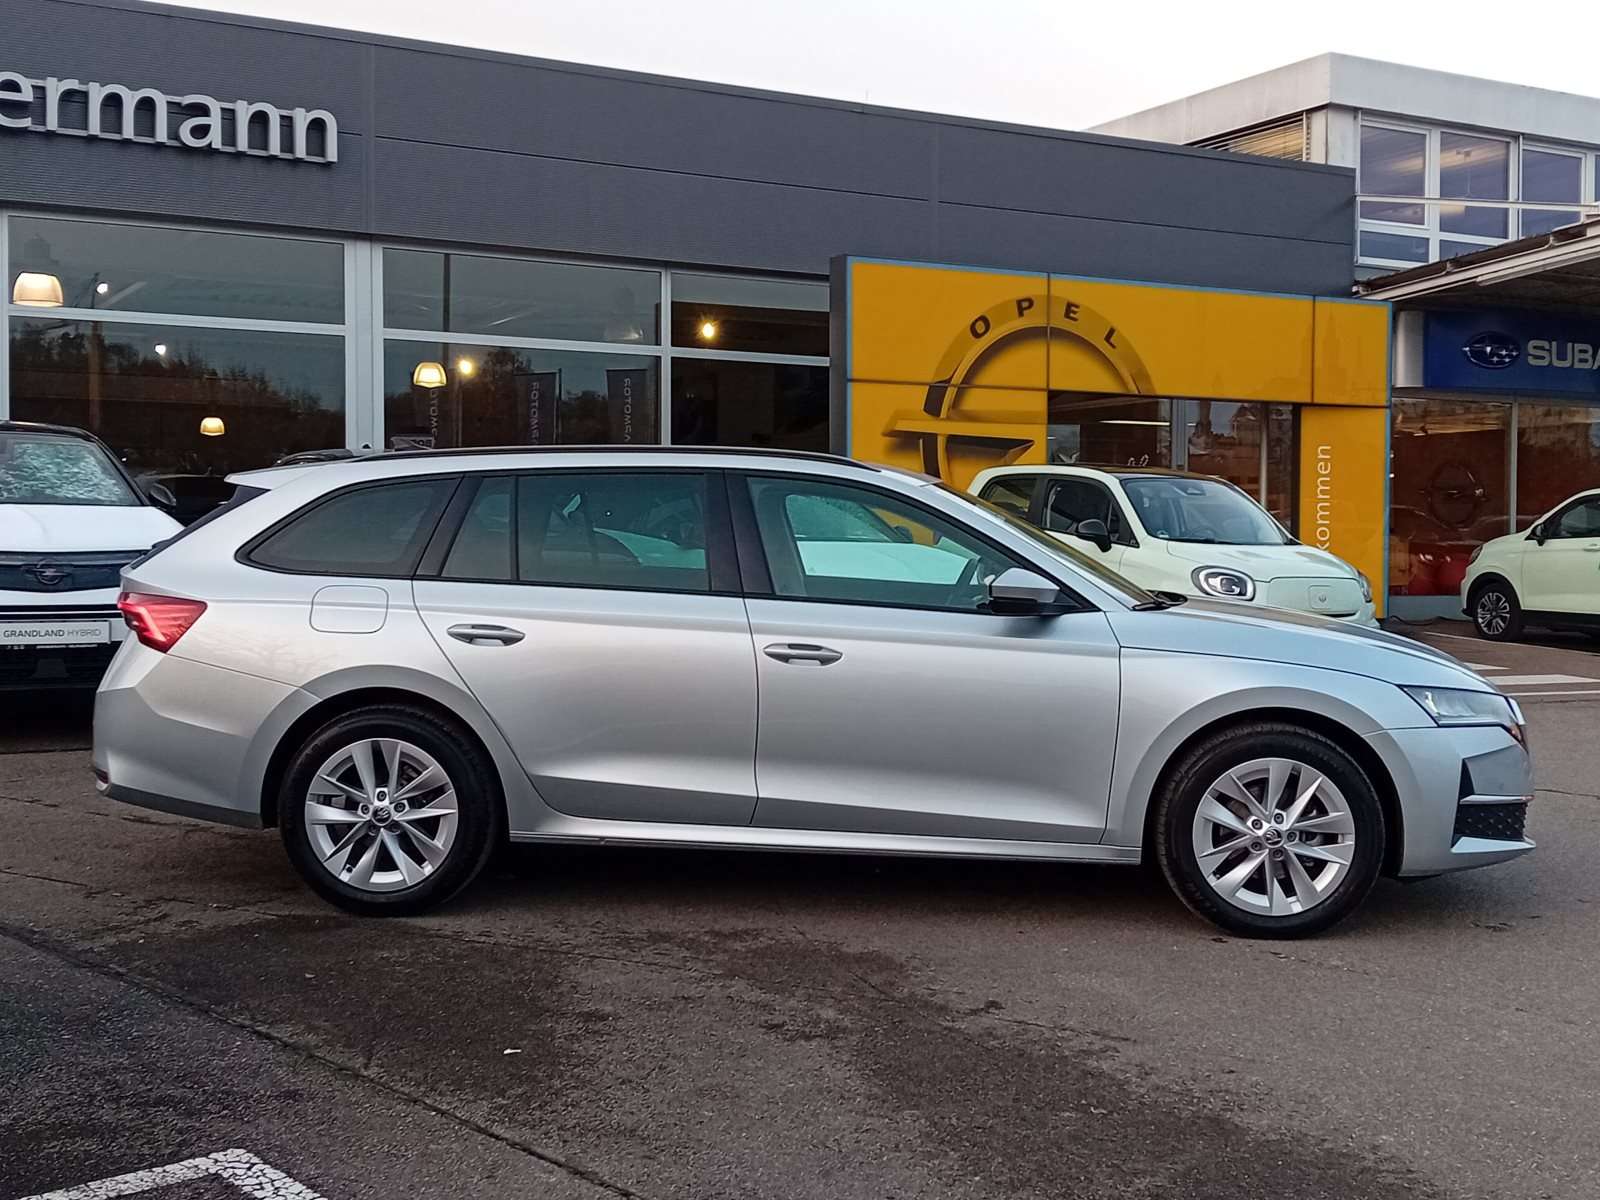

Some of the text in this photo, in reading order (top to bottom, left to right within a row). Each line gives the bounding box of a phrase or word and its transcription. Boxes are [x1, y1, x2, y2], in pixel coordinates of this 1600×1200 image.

[0, 71, 338, 163] ermann
[969, 297, 1118, 350] OPEL
[3, 628, 102, 638] GRANDLAND HYBRID
